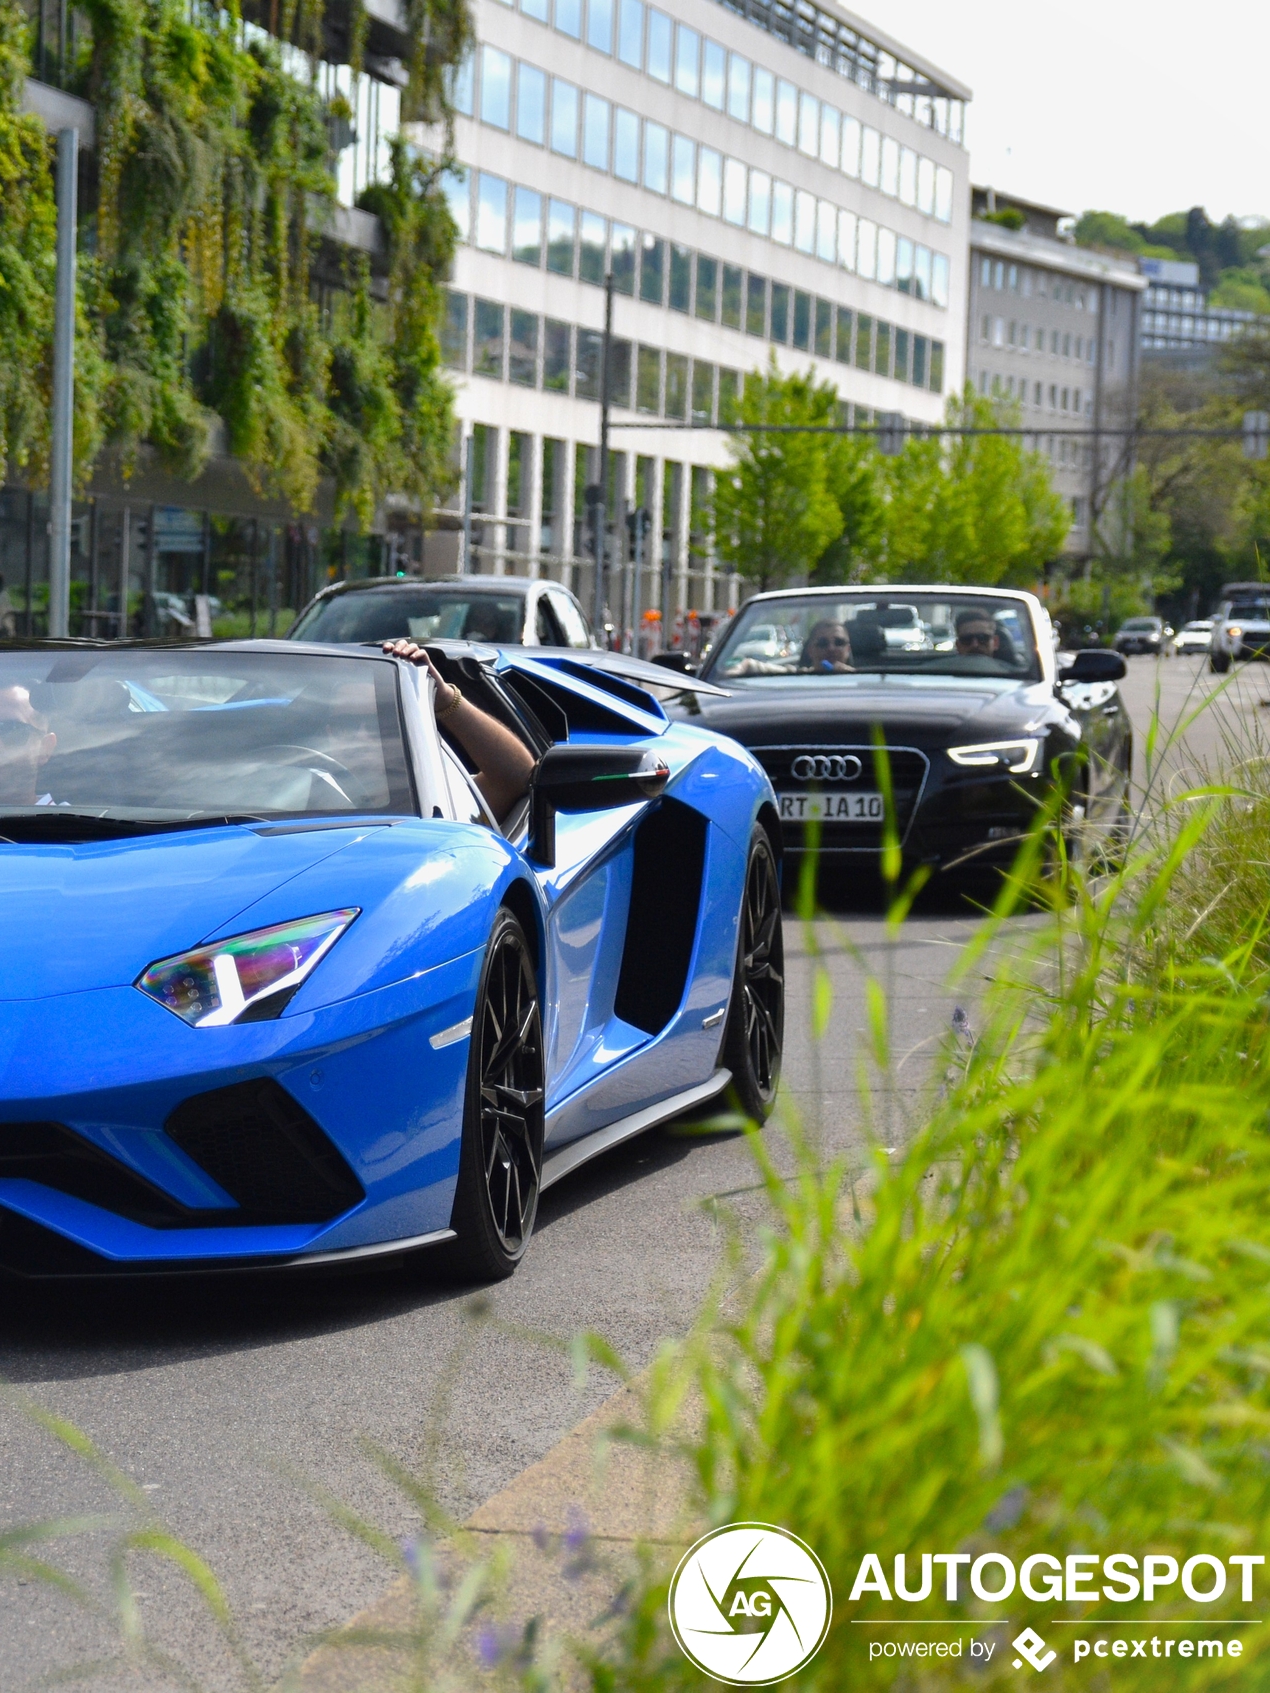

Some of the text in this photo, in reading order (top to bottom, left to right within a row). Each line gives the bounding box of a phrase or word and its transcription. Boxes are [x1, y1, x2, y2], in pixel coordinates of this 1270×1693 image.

[781, 797, 881, 818] RT IA 10
